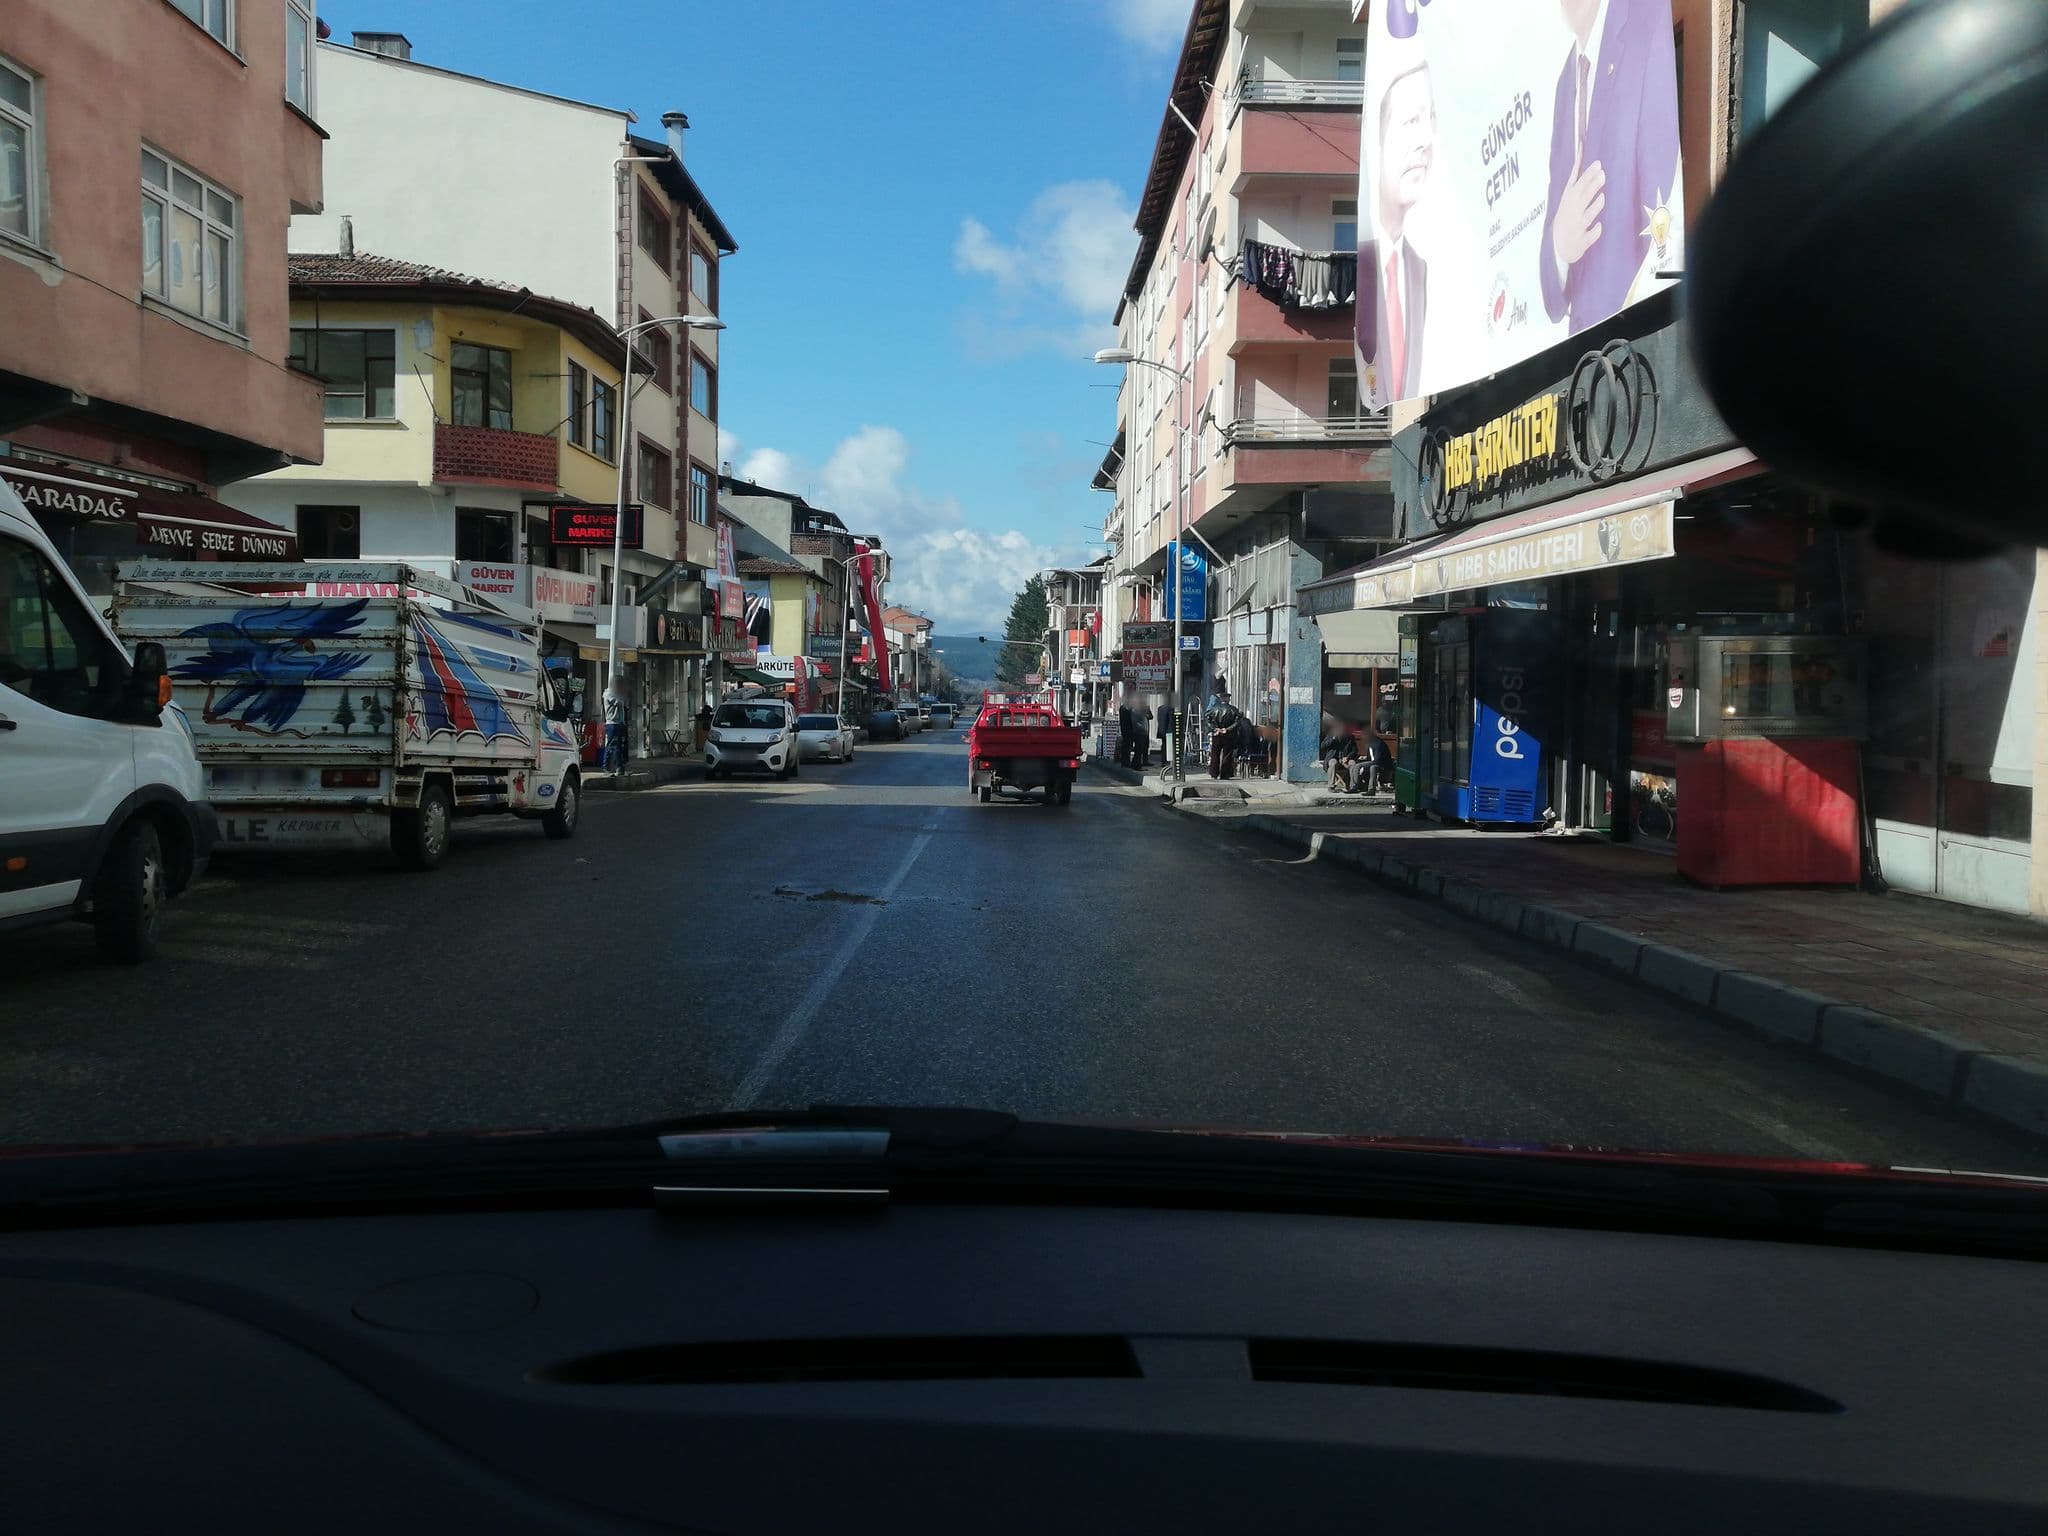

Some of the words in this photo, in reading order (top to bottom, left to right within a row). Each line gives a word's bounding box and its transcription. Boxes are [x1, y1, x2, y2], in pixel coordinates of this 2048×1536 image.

[1481, 90, 1533, 166] GÜNGÖR
[1485, 151, 1520, 212] ÇETİN
[1444, 432, 1473, 497] HBB
[1475, 392, 1560, 492] ŞARKÜTERİ
[9, 481, 126, 519] KARADAĞ
[149, 526, 194, 548] MEYVE
[202, 532, 235, 552] SEBZE
[242, 533, 286, 556] DÜNYASI
[568, 527, 615, 538] MARKE
[471, 567, 514, 580] GÜVEN
[1455, 553, 1484, 582] HBB
[472, 584, 514, 594] MARKET
[566, 580, 596, 608] MARKET
[757, 660, 795, 672] ARKÜTE
[1122, 650, 1171, 668] KASAP
[1495, 665, 1530, 760] pepsi
[224, 817, 270, 842] LE
[276, 819, 343, 832] KAPORTA
